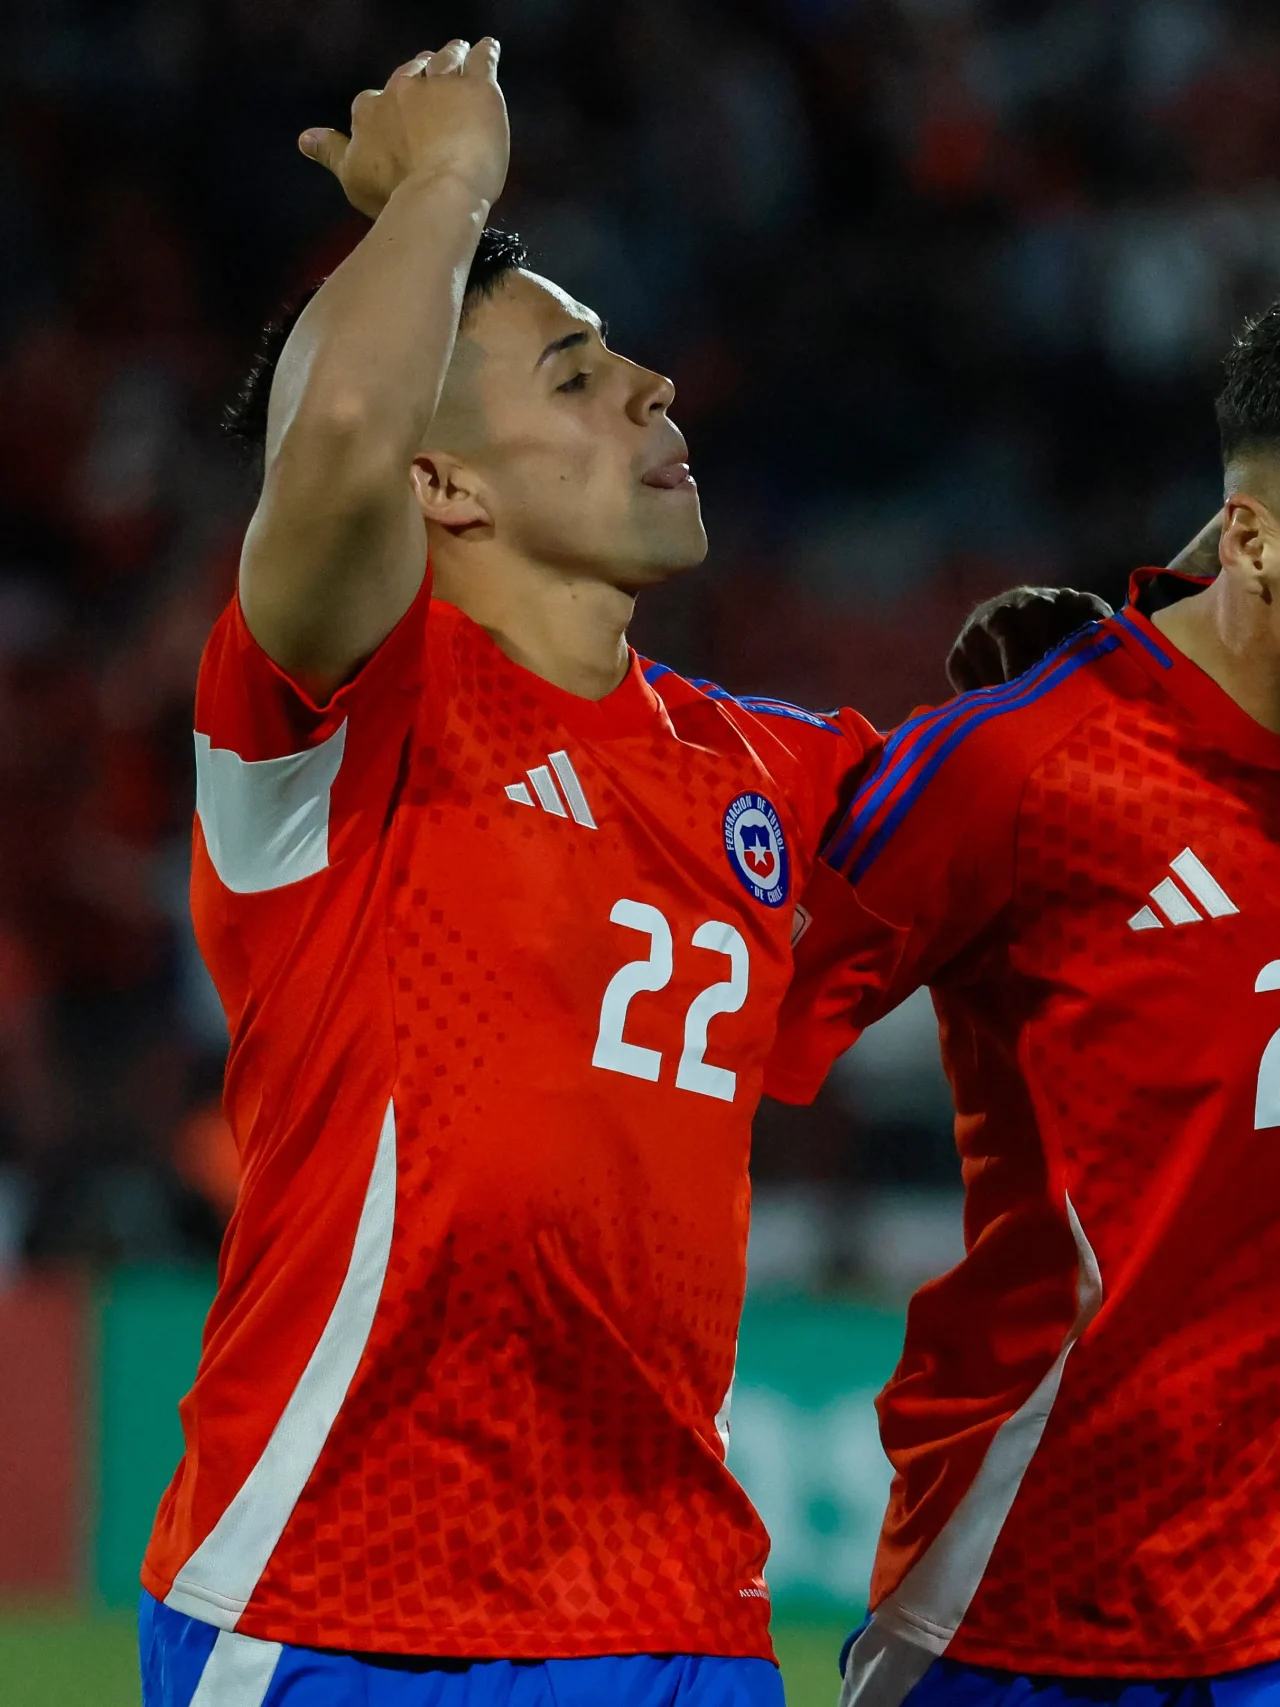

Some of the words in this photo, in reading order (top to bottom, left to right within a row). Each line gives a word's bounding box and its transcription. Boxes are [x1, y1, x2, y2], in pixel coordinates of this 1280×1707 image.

[725, 795, 752, 852] FEDERACION
[756, 796, 767, 812] DE
[591, 899, 750, 1103] 22
